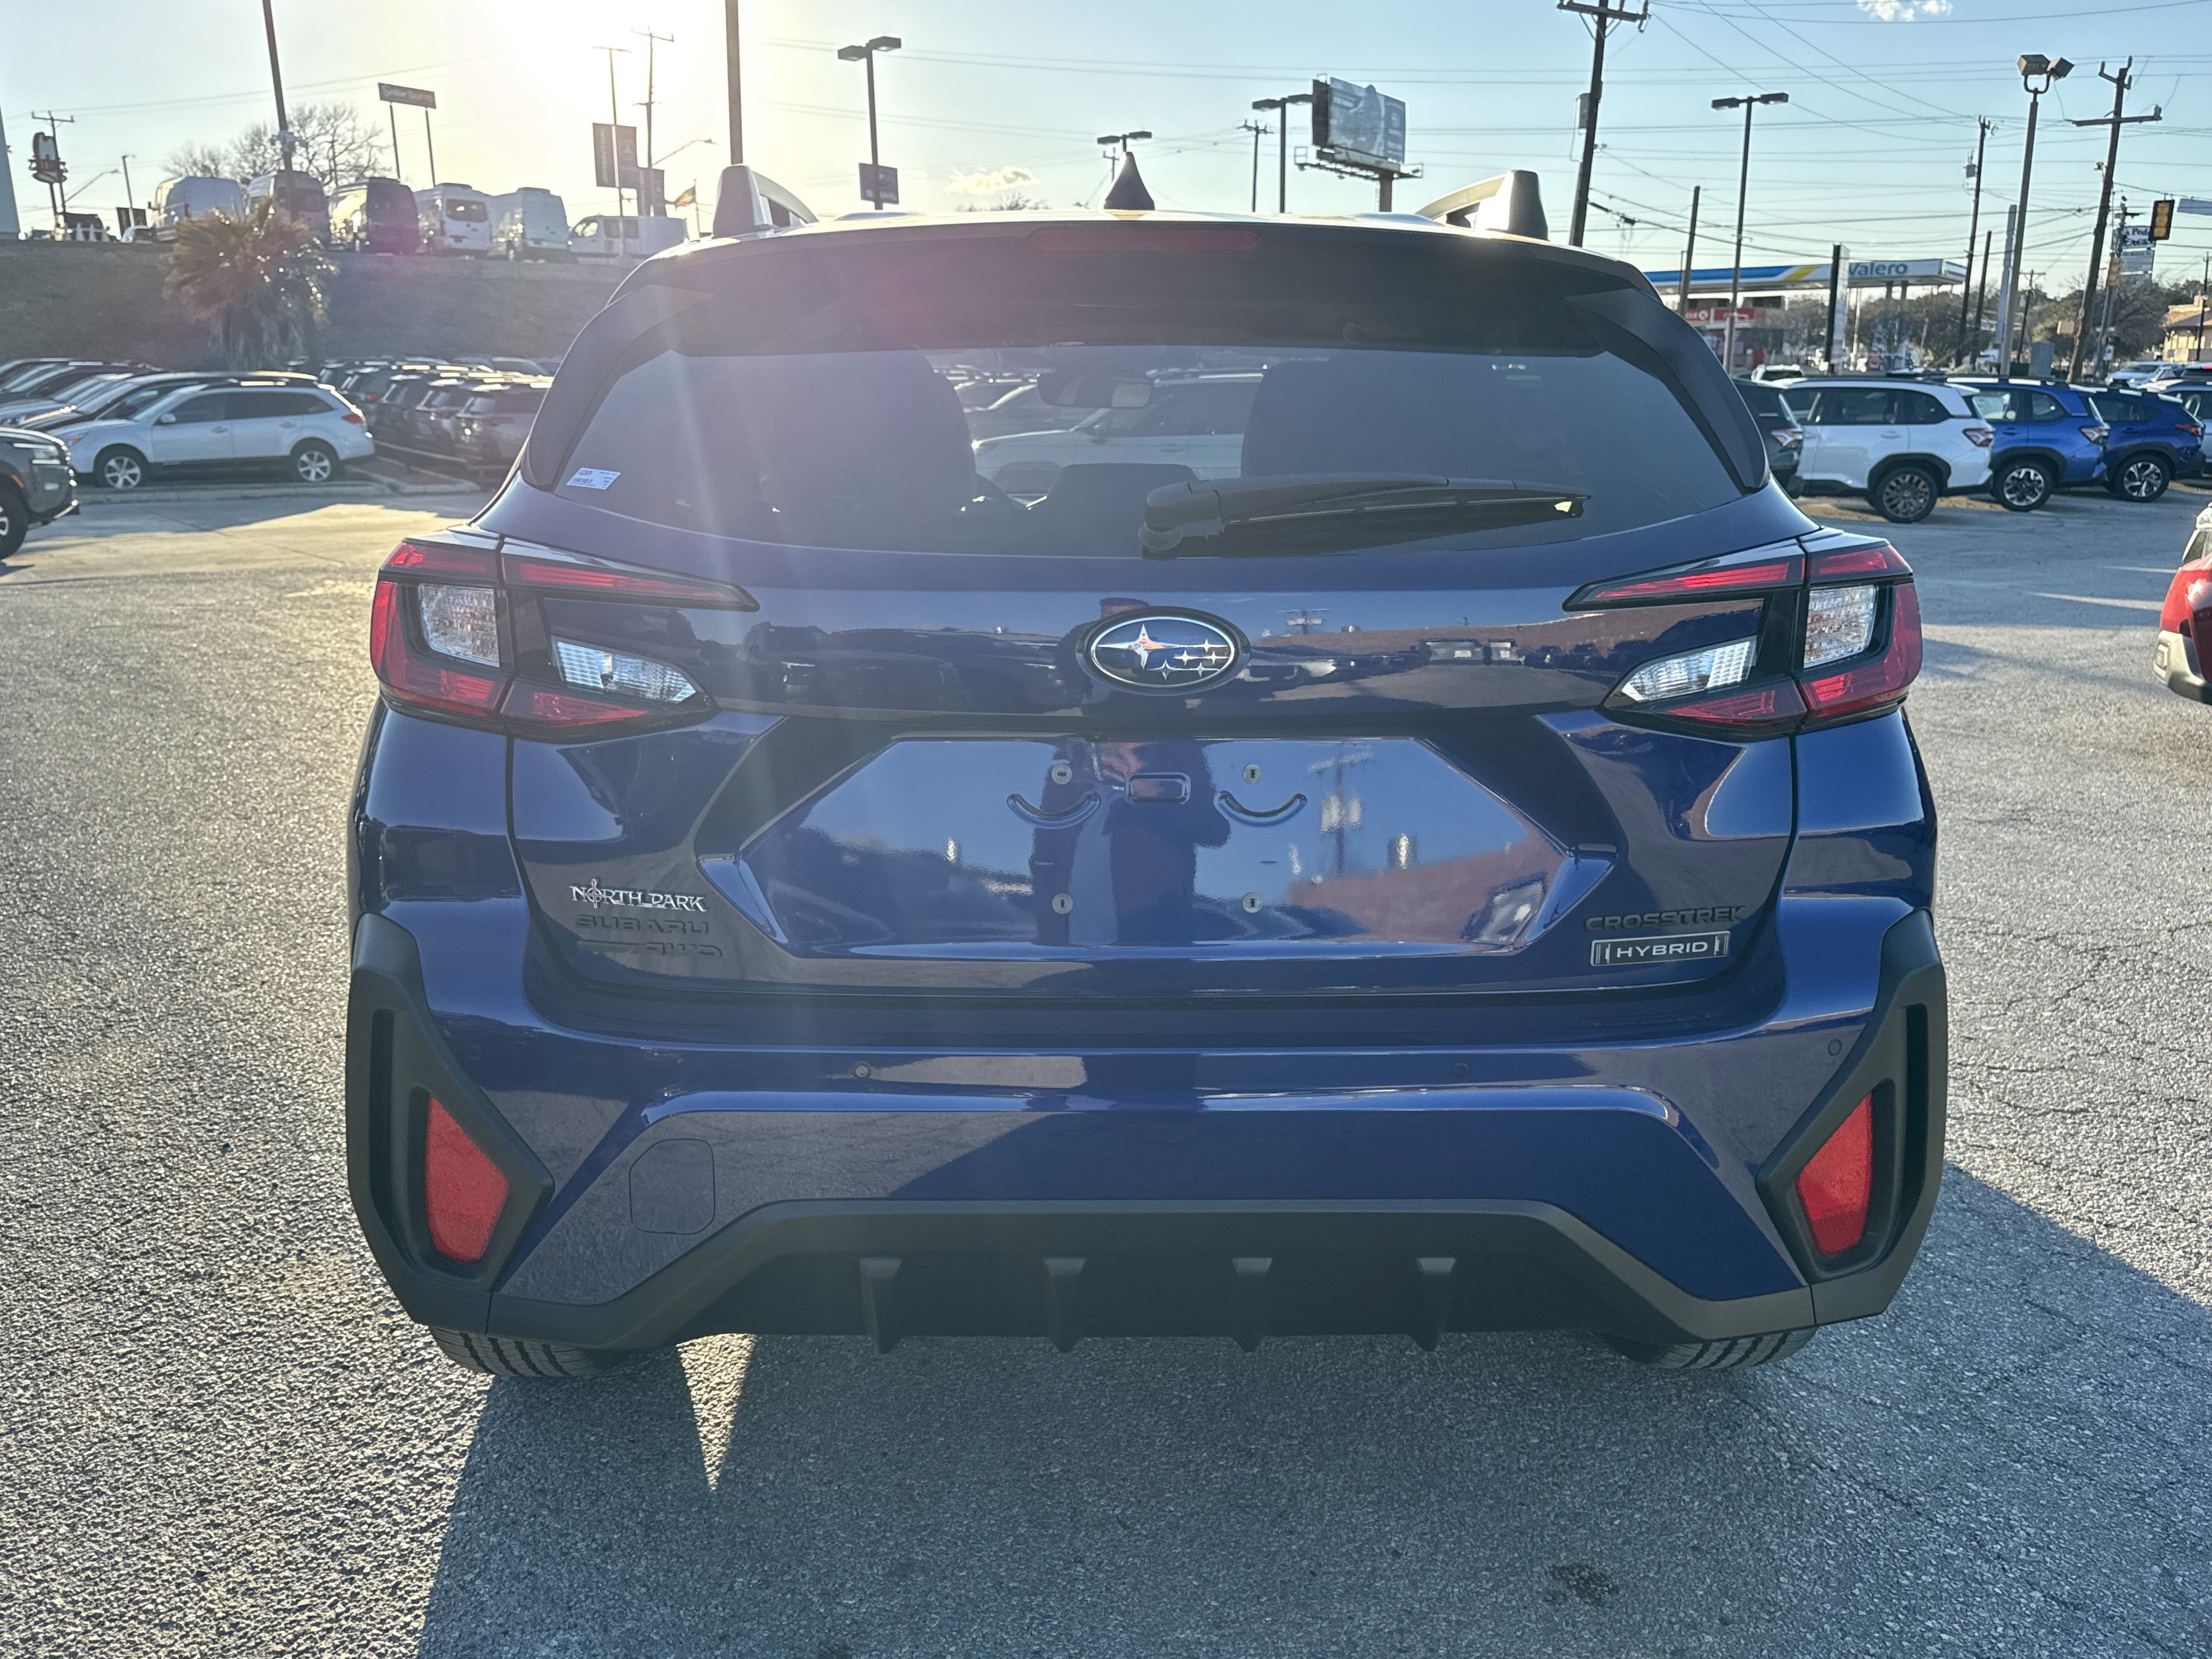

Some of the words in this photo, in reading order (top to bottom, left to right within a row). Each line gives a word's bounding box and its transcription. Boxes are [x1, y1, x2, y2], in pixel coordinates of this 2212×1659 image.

[1849, 262, 1908, 276] Valero
[569, 878, 644, 908] NORTH
[648, 893, 707, 912] PARK
[576, 913, 709, 935] SUBARU
[1583, 905, 1746, 930] CROSSTREK
[641, 941, 723, 958] AWD
[1616, 941, 1708, 958] HYBRID
